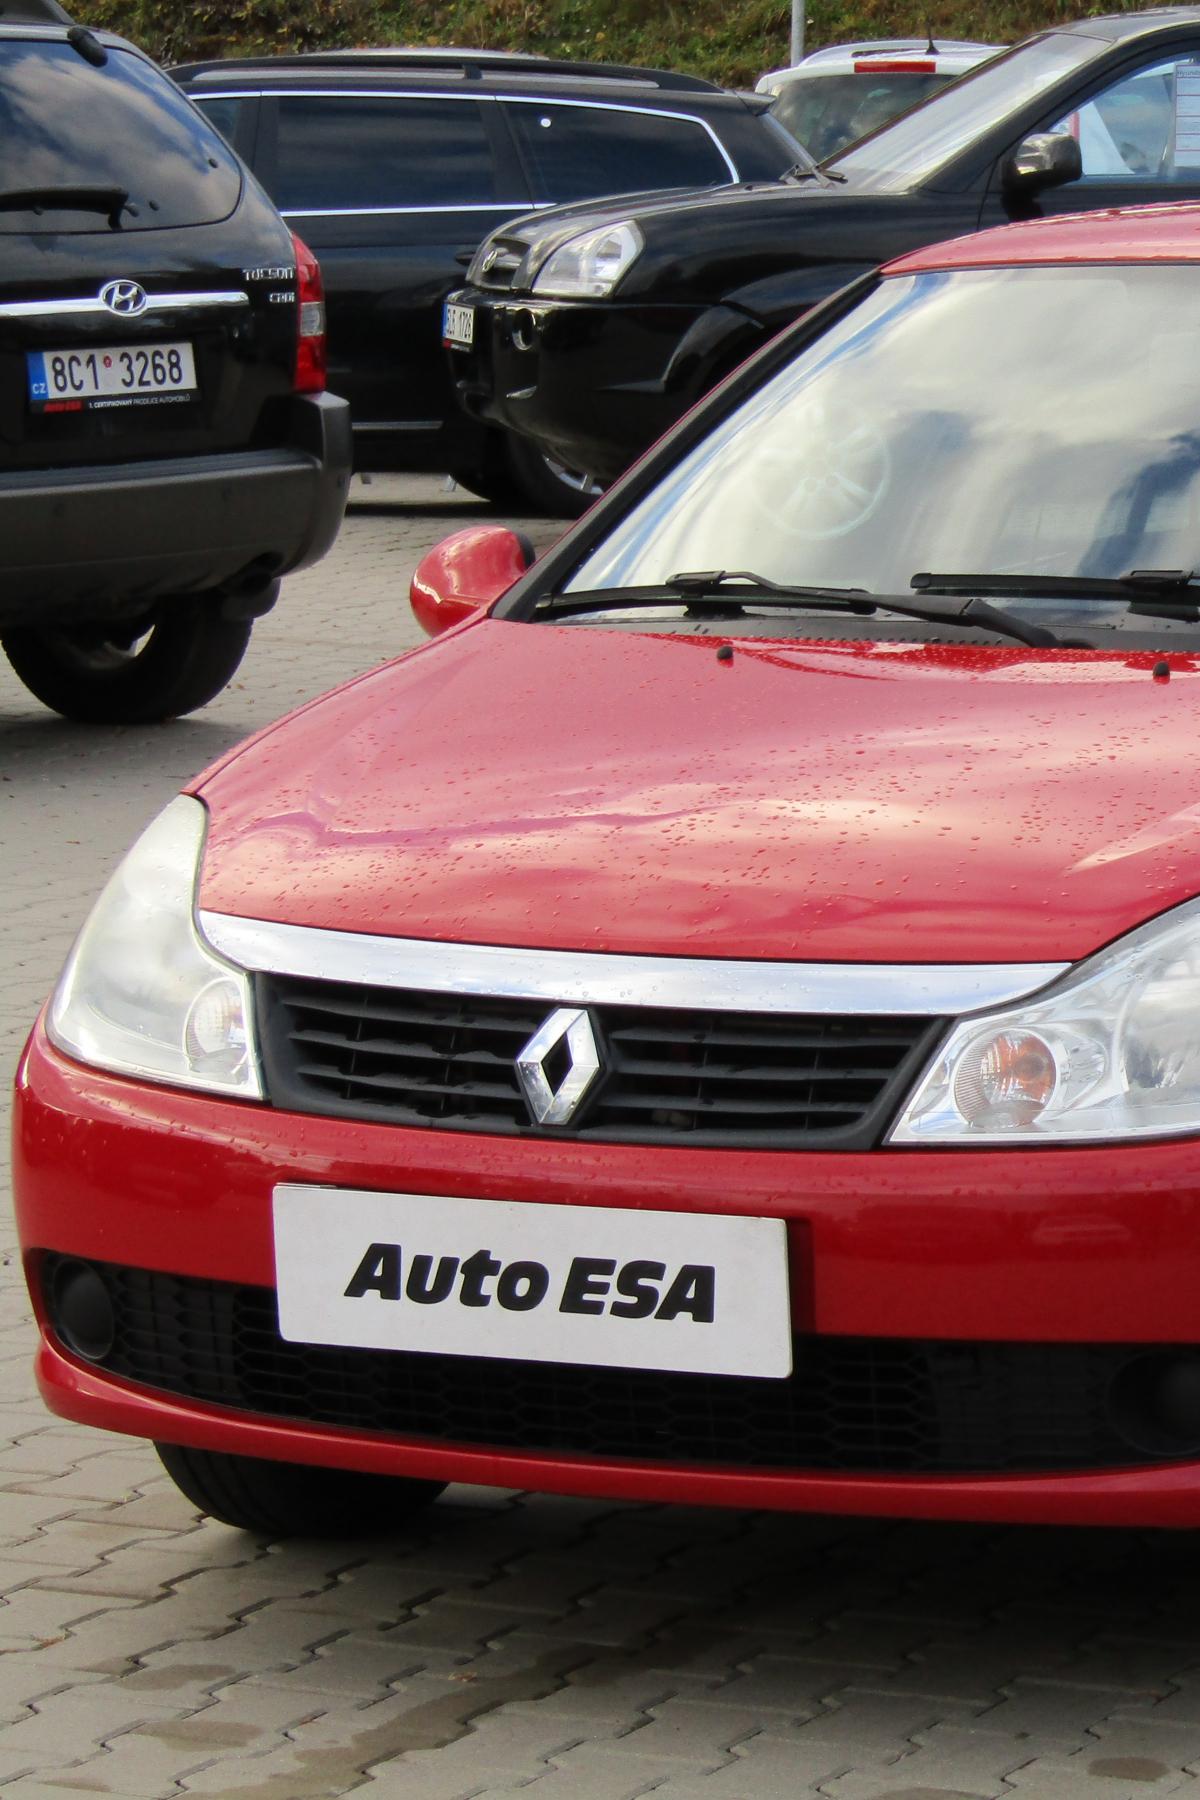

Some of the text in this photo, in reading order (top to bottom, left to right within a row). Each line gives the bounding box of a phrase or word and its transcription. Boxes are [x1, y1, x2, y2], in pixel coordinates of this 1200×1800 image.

[242, 267, 295, 280] TUCSON
[52, 349, 183, 392] 8C1 3268
[32, 383, 47, 394] CZ
[344, 1243, 715, 1323] Auto ESA
